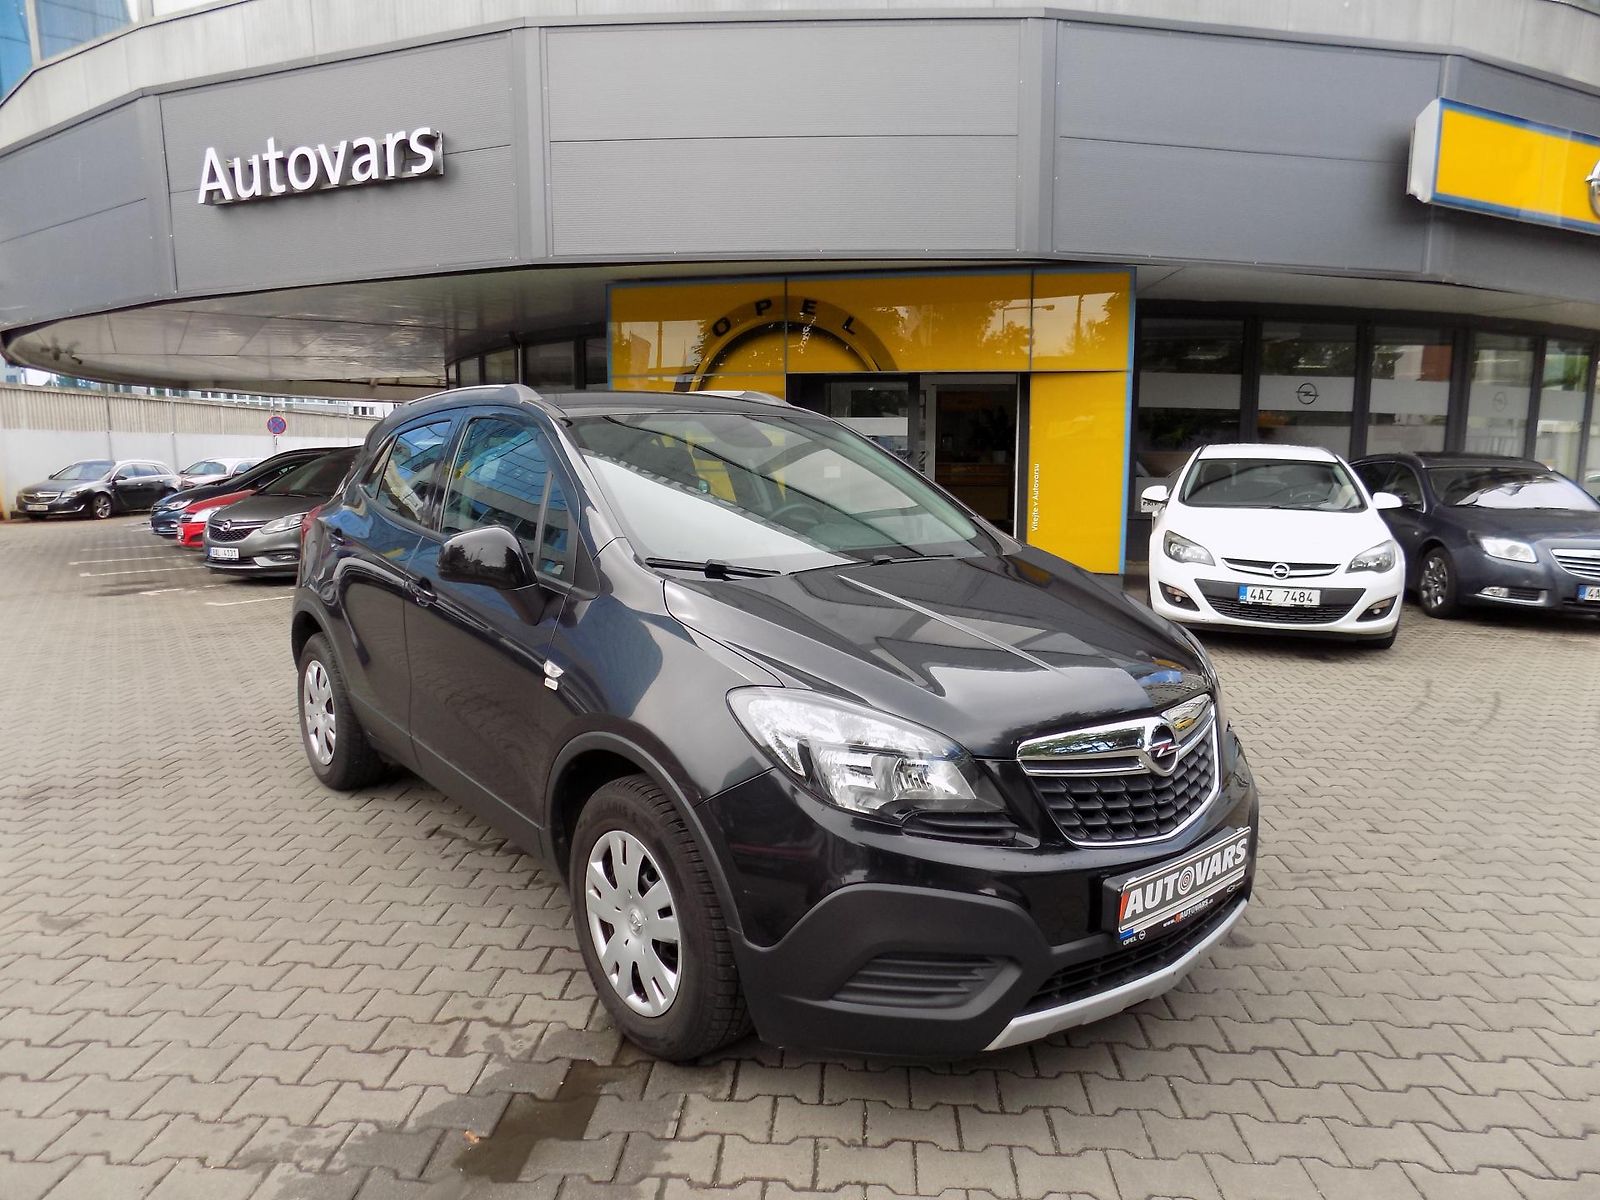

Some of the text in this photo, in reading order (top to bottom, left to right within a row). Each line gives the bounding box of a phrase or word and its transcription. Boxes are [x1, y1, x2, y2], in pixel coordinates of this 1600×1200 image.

[198, 127, 434, 204] Autovars
[711, 298, 857, 337] OPEL
[1249, 588, 1313, 603] 4AZ 7484
[1123, 838, 1247, 919] AUTOVARS
